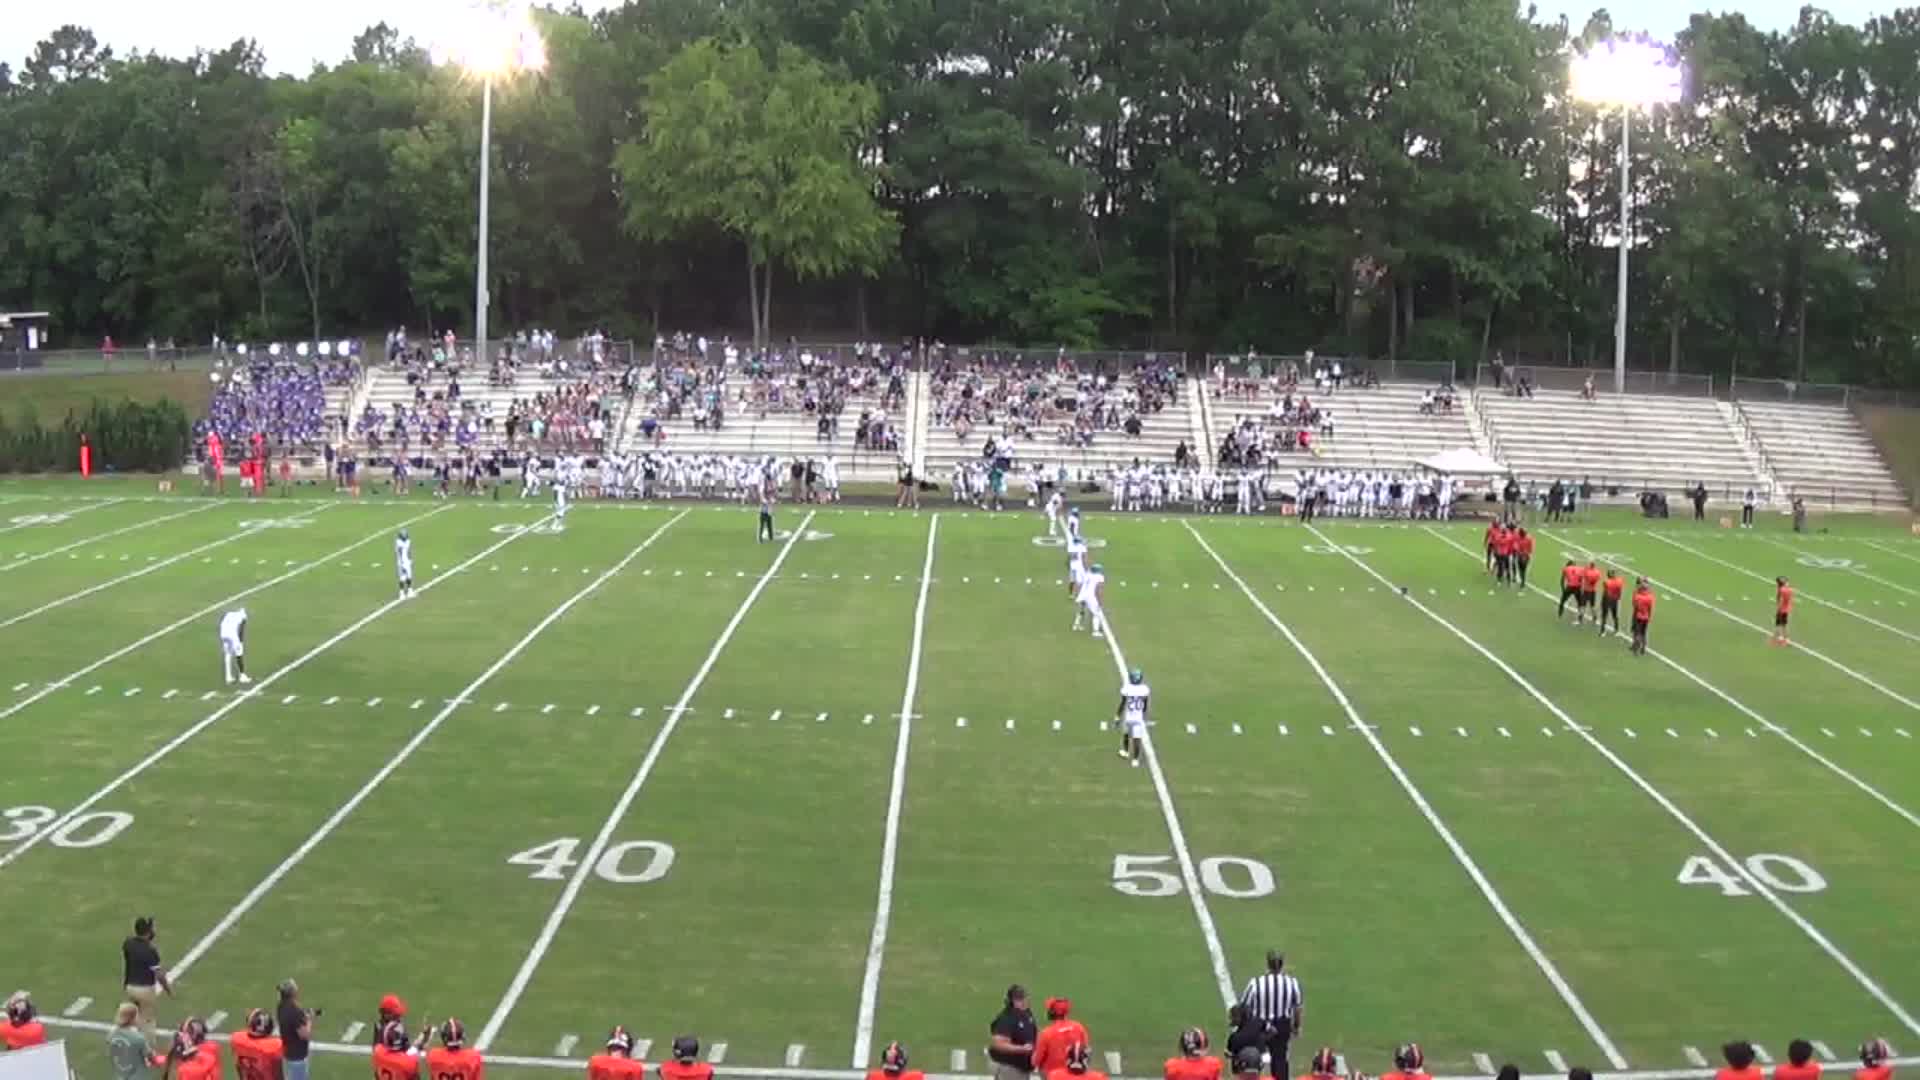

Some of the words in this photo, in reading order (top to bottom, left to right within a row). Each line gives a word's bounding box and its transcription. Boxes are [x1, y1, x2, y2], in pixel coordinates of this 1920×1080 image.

[1127, 695, 1144, 712] 20
[0, 806, 134, 847] 30
[507, 837, 675, 882] 40
[1112, 855, 1276, 897] 50
[1677, 854, 1826, 896] 40
